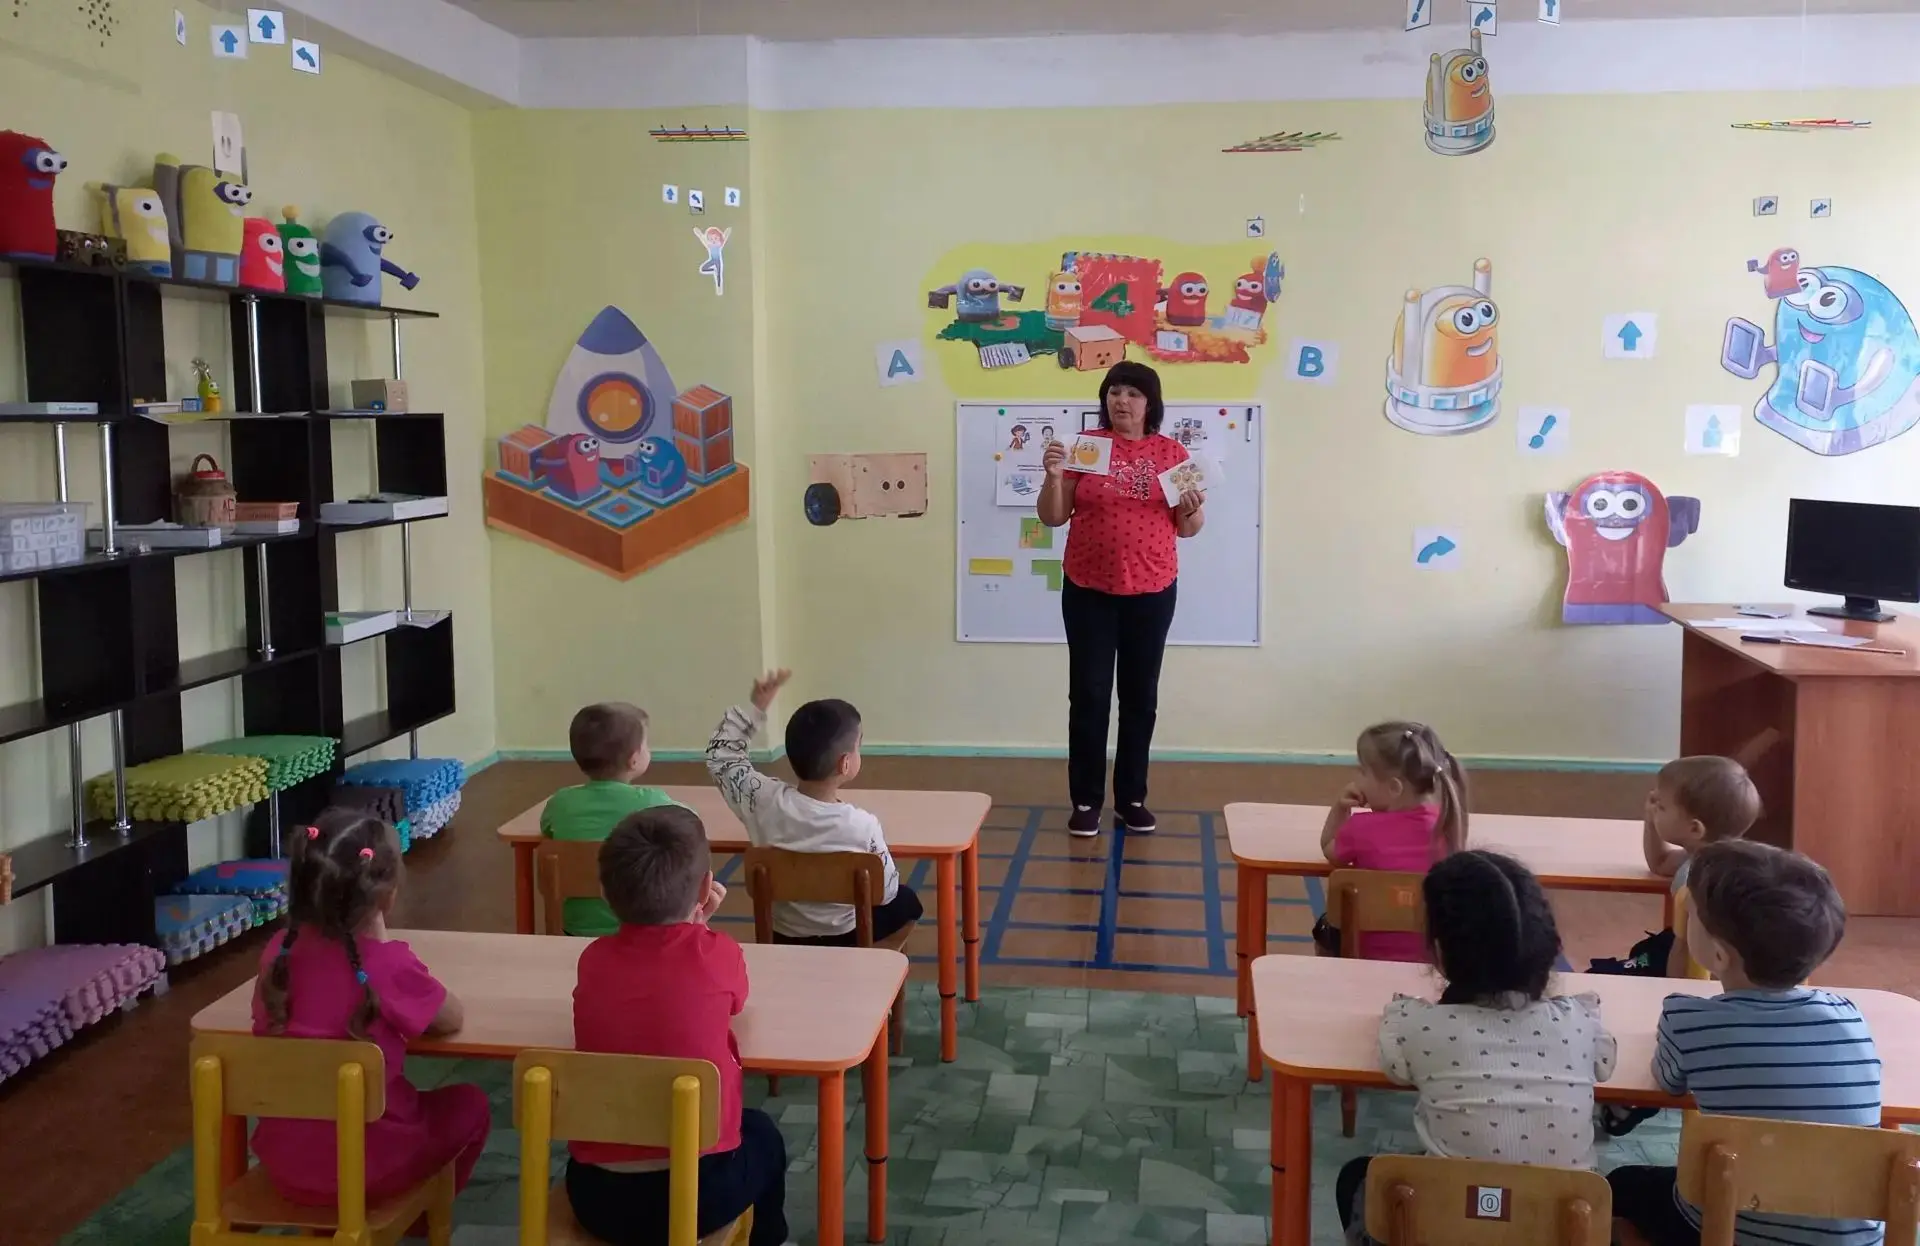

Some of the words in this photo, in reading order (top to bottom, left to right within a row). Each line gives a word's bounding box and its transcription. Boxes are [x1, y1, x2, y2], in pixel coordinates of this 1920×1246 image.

[1091, 283, 1135, 317] 4
[887, 349, 914, 378] A
[1297, 346, 1324, 377] B
